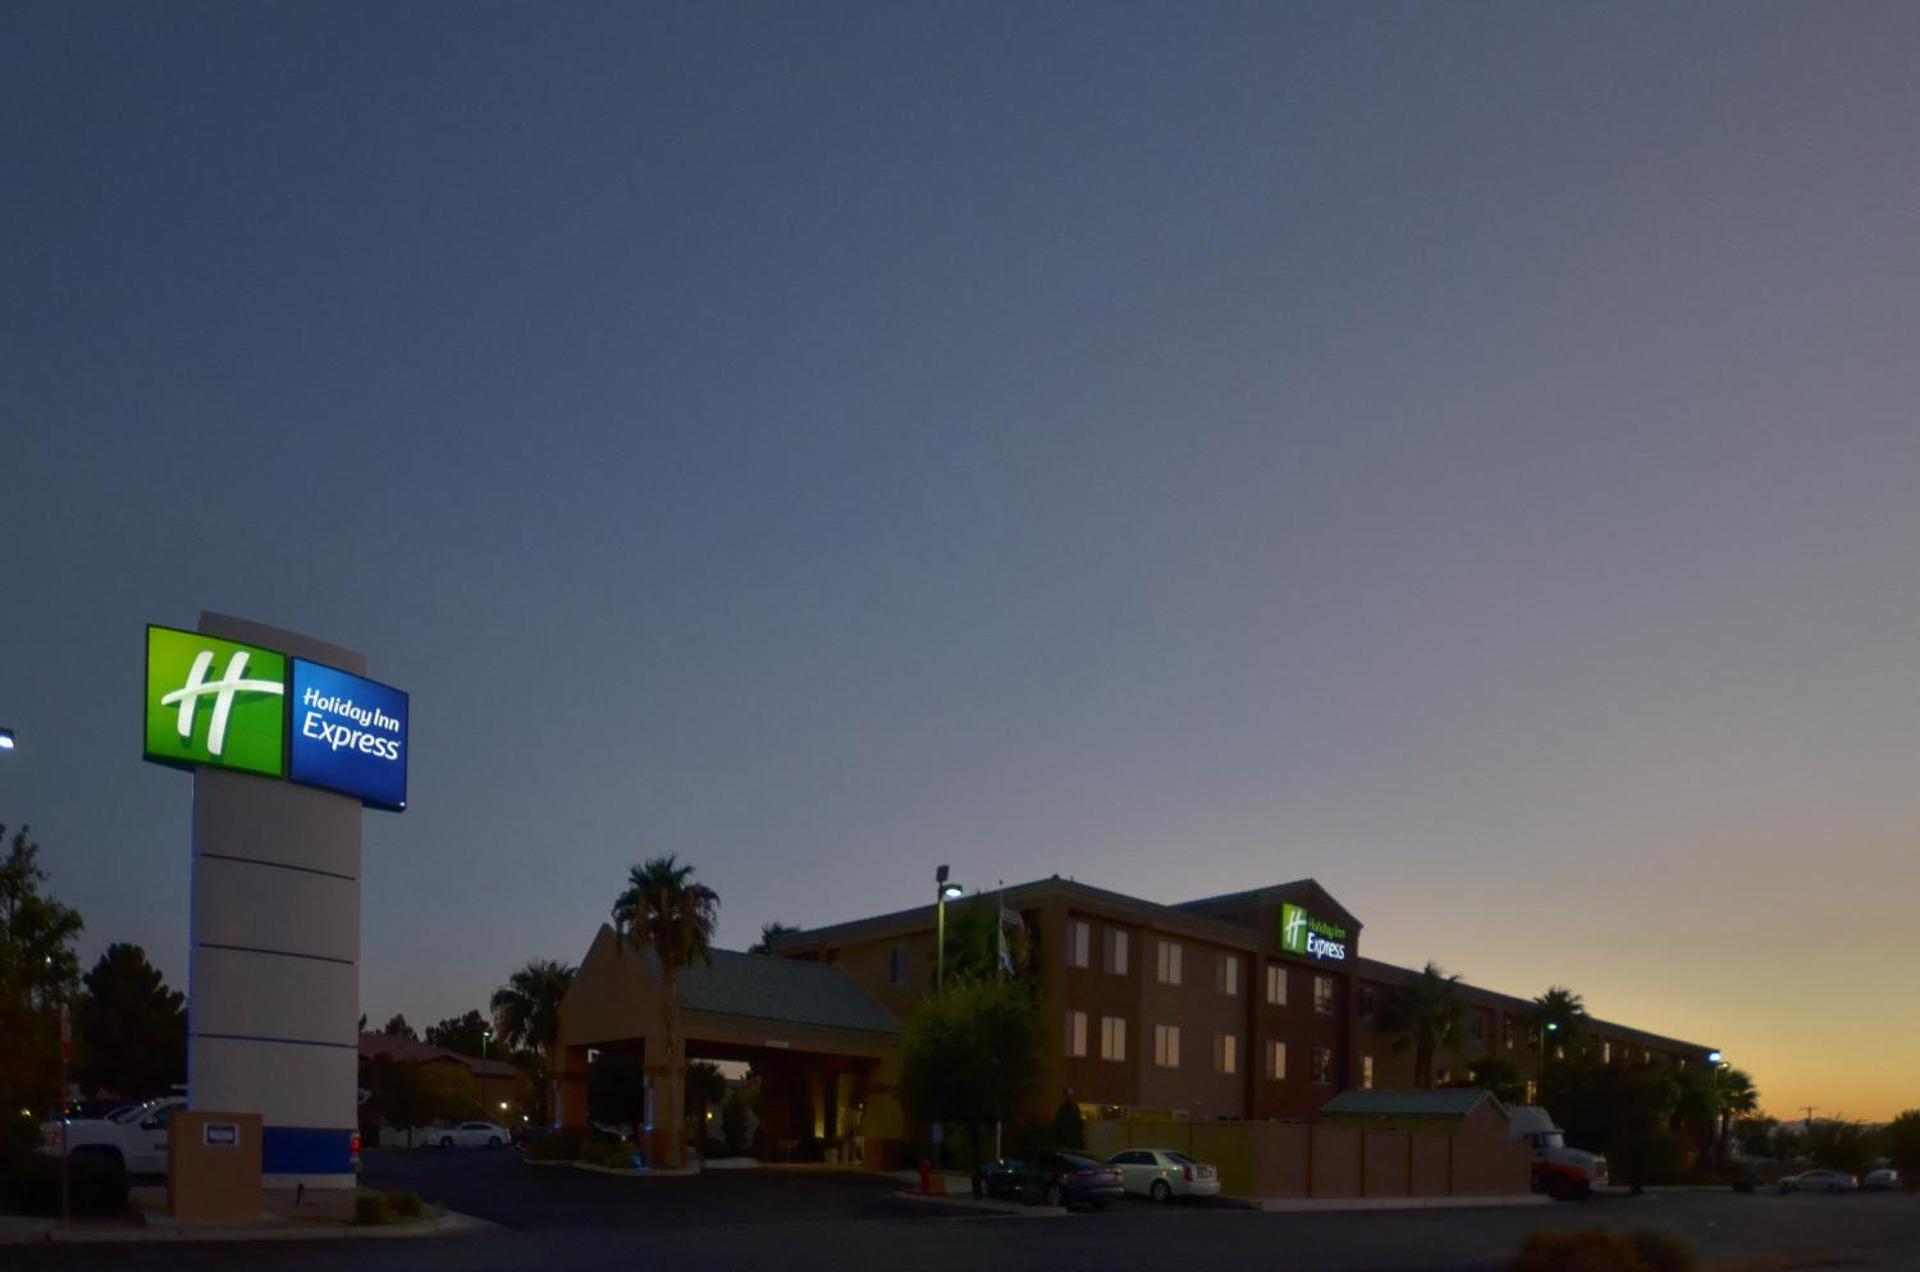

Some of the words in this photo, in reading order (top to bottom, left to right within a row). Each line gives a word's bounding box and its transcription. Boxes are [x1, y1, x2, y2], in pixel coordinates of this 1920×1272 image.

[303, 687, 372, 727] Holiday
[374, 707, 400, 733] Inn
[303, 711, 399, 760] Express
[1307, 931, 1345, 960] Express
